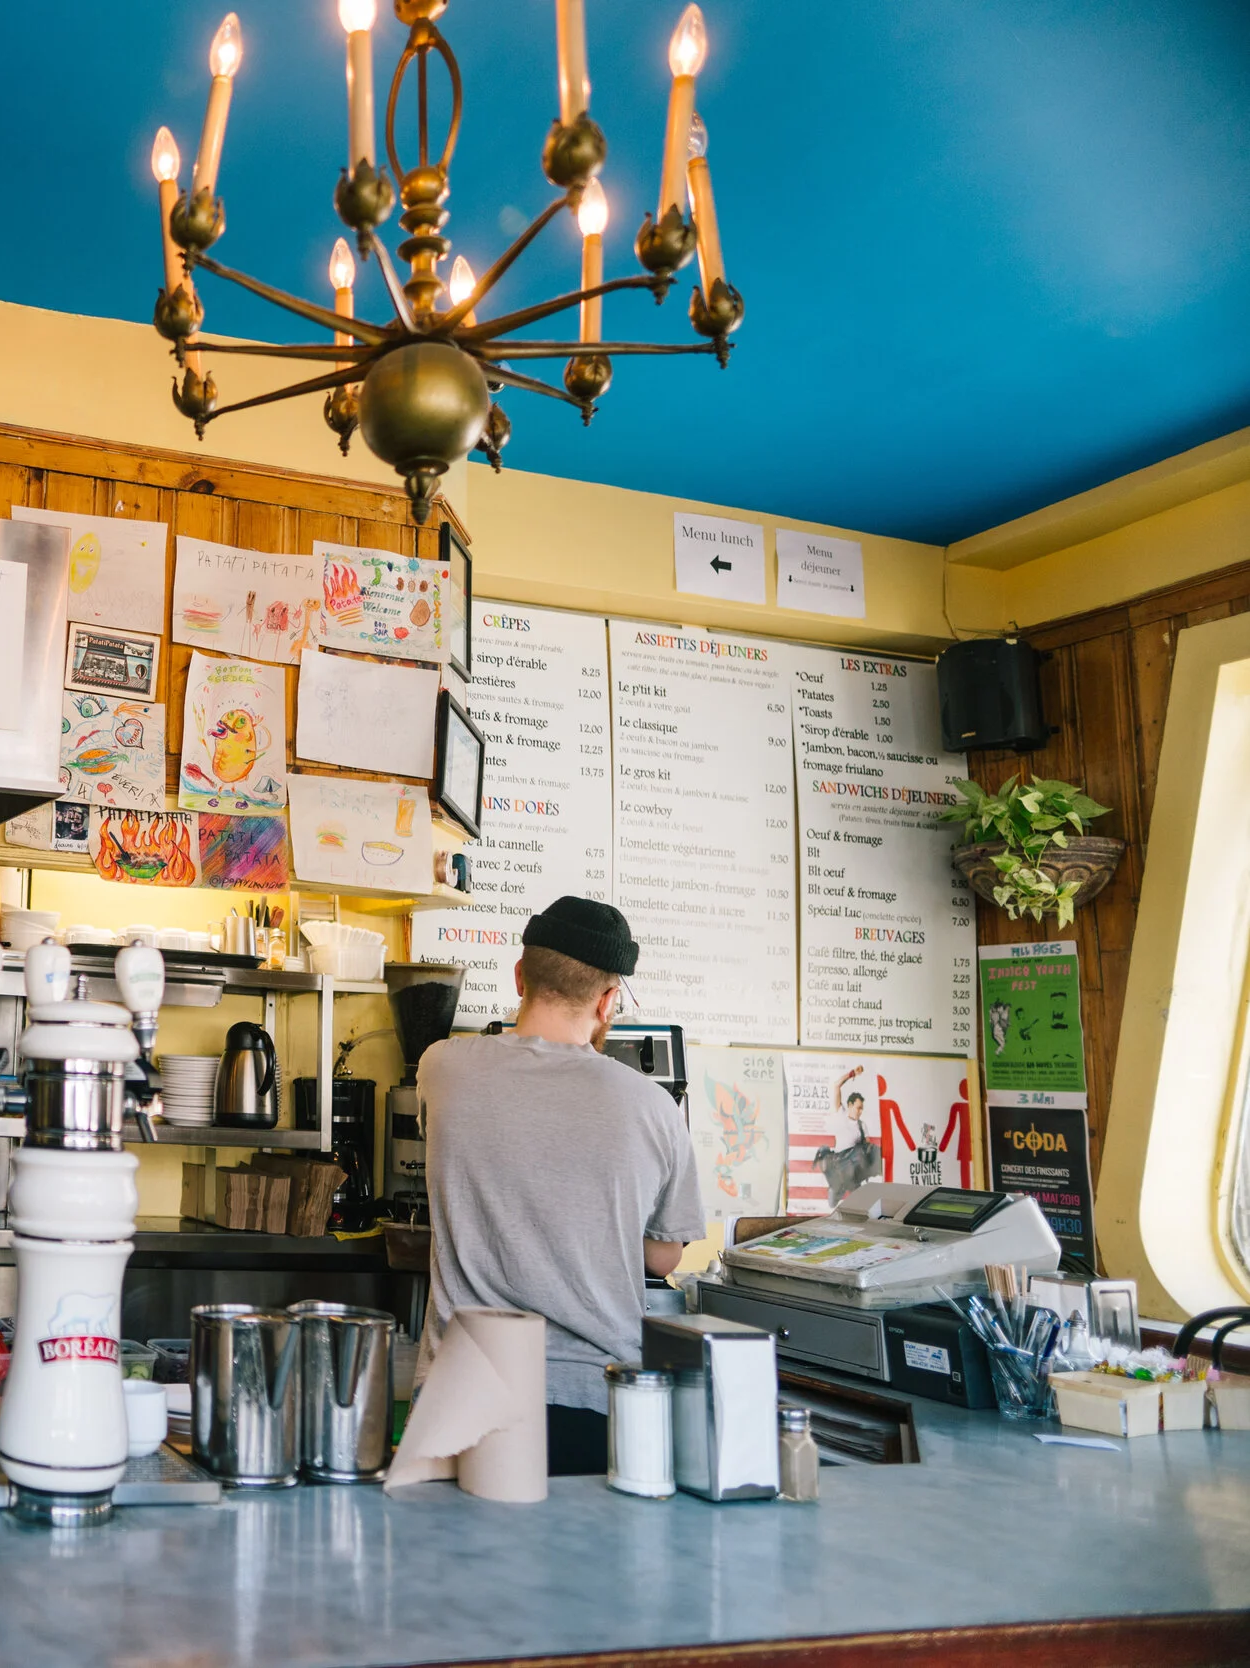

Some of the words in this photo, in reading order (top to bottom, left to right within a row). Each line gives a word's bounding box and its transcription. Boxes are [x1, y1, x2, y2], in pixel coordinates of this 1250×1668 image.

[682, 526, 716, 542] Menu
[720, 531, 754, 547] lunch
[807, 545, 833, 558] Menu
[801, 561, 841, 577] déjeuner
[362, 601, 401, 616] Welcome
[483, 614, 530, 632] CRÊPES
[635, 631, 697, 652] ASSIETTES
[699, 640, 768, 662] DÉJEUNERS
[476, 652, 503, 667] sirop
[506, 655, 547, 671] d'érable
[841, 658, 860, 672] LES
[863, 661, 907, 678] EXTRAS
[471, 674, 516, 688] restières
[618, 681, 630, 692] Le
[632, 683, 651, 698] p'tit
[654, 685, 667, 698] kit
[493, 711, 502, 723] &
[505, 713, 549, 730] fromage
[619, 716, 630, 728] Le
[633, 718, 678, 734] classique
[832, 727, 869, 741] d'érable
[505, 734, 514, 745] &
[517, 735, 561, 752] fromage
[886, 751, 924, 765] saucisse
[925, 756, 938, 766] ou
[620, 764, 631, 776] Le
[634, 767, 655, 780] gros
[658, 768, 671, 781] kit
[803, 759, 843, 775] fromage
[845, 763, 884, 777] friulano
[77, 782, 87, 799] 4
[812, 780, 889, 800] SANDWICHS
[892, 786, 958, 806] DÉJEUNERS
[514, 799, 560, 816] DORÉS
[620, 800, 631, 812] Le
[634, 802, 673, 819] cowboy
[486, 836, 496, 848] la
[499, 838, 544, 853] cannelle
[806, 828, 831, 841] Oeuf
[833, 830, 841, 841] &
[843, 831, 883, 847] fromage
[620, 837, 670, 852] L'omelette
[672, 844, 736, 859] végétarienne
[807, 846, 820, 858] Blt
[223, 850, 281, 865] PATATA
[476, 860, 501, 871] avec
[504, 860, 511, 871] 2
[513, 860, 542, 874] oeufs
[807, 865, 821, 877] Blt
[823, 867, 845, 878] oeuf
[501, 881, 525, 894] doré
[619, 873, 669, 888] L'omelette
[671, 880, 756, 898] jambon-fromage
[807, 883, 821, 895] Blt
[823, 886, 845, 897] oeuf
[847, 887, 855, 897] &
[857, 887, 897, 903] fromage
[500, 902, 533, 917] bacon
[619, 896, 669, 911] L'omelette
[671, 902, 707, 914] cabane
[719, 908, 745, 918] sucre
[844, 907, 862, 919] Luc
[437, 927, 508, 945] POUTINES
[672, 936, 690, 948] Luc
[855, 927, 925, 944] BREUVAGES
[468, 957, 499, 970] oeufs
[807, 946, 830, 958] Café
[832, 948, 858, 961] filtre,
[880, 950, 895, 963] thé
[897, 952, 923, 965] glacé
[807, 962, 850, 977] Espresso,
[852, 965, 888, 979] allongé
[464, 980, 498, 992] bacon
[807, 979, 829, 991] Café
[831, 982, 844, 992] au
[847, 981, 862, 993] lait
[1011, 981, 1037, 991] FEST
[490, 1002, 500, 1014] &
[807, 996, 850, 1009] Chocolat
[852, 997, 882, 1010] chaud
[878, 1017, 893, 1030] jus
[895, 1017, 932, 1031] tropical
[824, 1030, 861, 1042] fameux
[863, 1033, 878, 1045] jus
[881, 1033, 914, 1046] pressés
[743, 1055, 775, 1068] ciné
[792, 1084, 830, 1099] DEAR
[1017, 1093, 1028, 1104] 3
[1013, 1130, 1068, 1153] CODA
[909, 1161, 942, 1176] CUISINE
[1001, 1163, 1024, 1174] CONCERT
[1025, 1165, 1036, 1175] DES
[1037, 1166, 1070, 1178] FINISSANTS
[911, 1174, 920, 1185] TA
[921, 1174, 942, 1185] VILLE
[1042, 1192, 1059, 1205] MAI
[1060, 1193, 1081, 1207] 2019
[1049, 1216, 1082, 1235] 9H30
[42, 1337, 119, 1361] BORÉALE
